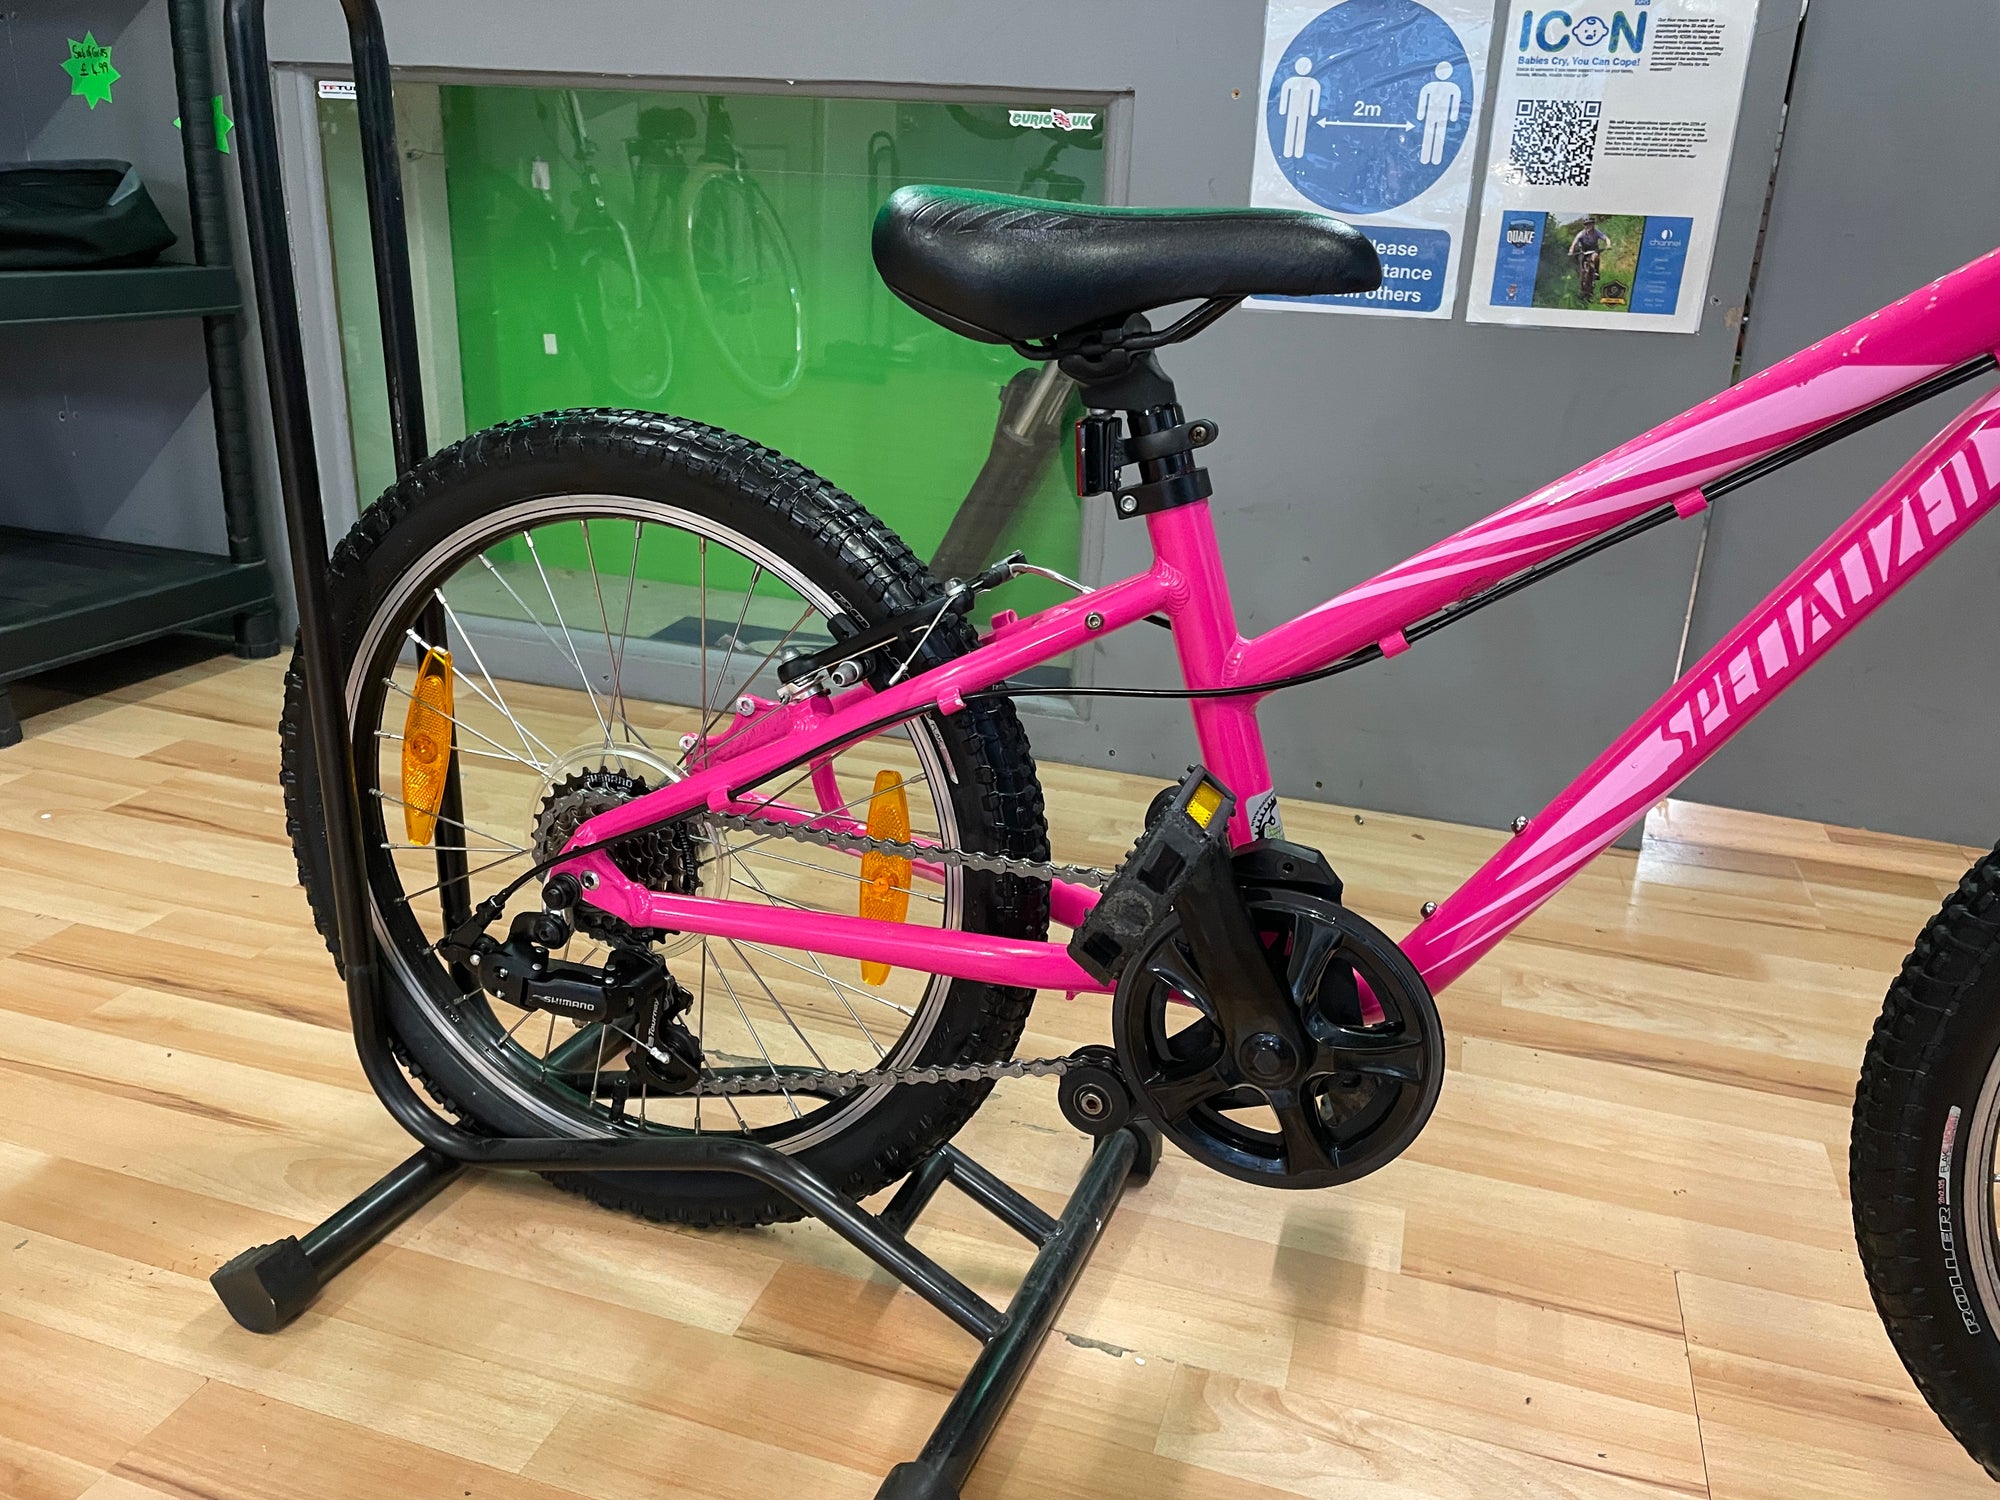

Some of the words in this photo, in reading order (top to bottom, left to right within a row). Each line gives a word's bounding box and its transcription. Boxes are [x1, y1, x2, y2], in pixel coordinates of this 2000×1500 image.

[1518, 56, 1549, 65] Babies
[1551, 57, 1569, 67] Cry,
[1572, 57, 1590, 66] You
[1592, 58, 1610, 66] Can
[1612, 58, 1641, 68] Cope!
[1353, 101, 1382, 117] 2m
[1072, 115, 1092, 127] UK
[1506, 230, 1536, 245] QUAKE
[1373, 240, 1418, 256] lease
[1382, 264, 1433, 280] tance
[1365, 285, 1421, 303] others
[543, 995, 595, 1011] SHIMANO
[647, 998, 660, 1037] Tourney
[1939, 1206, 1981, 1334] ROLLER
